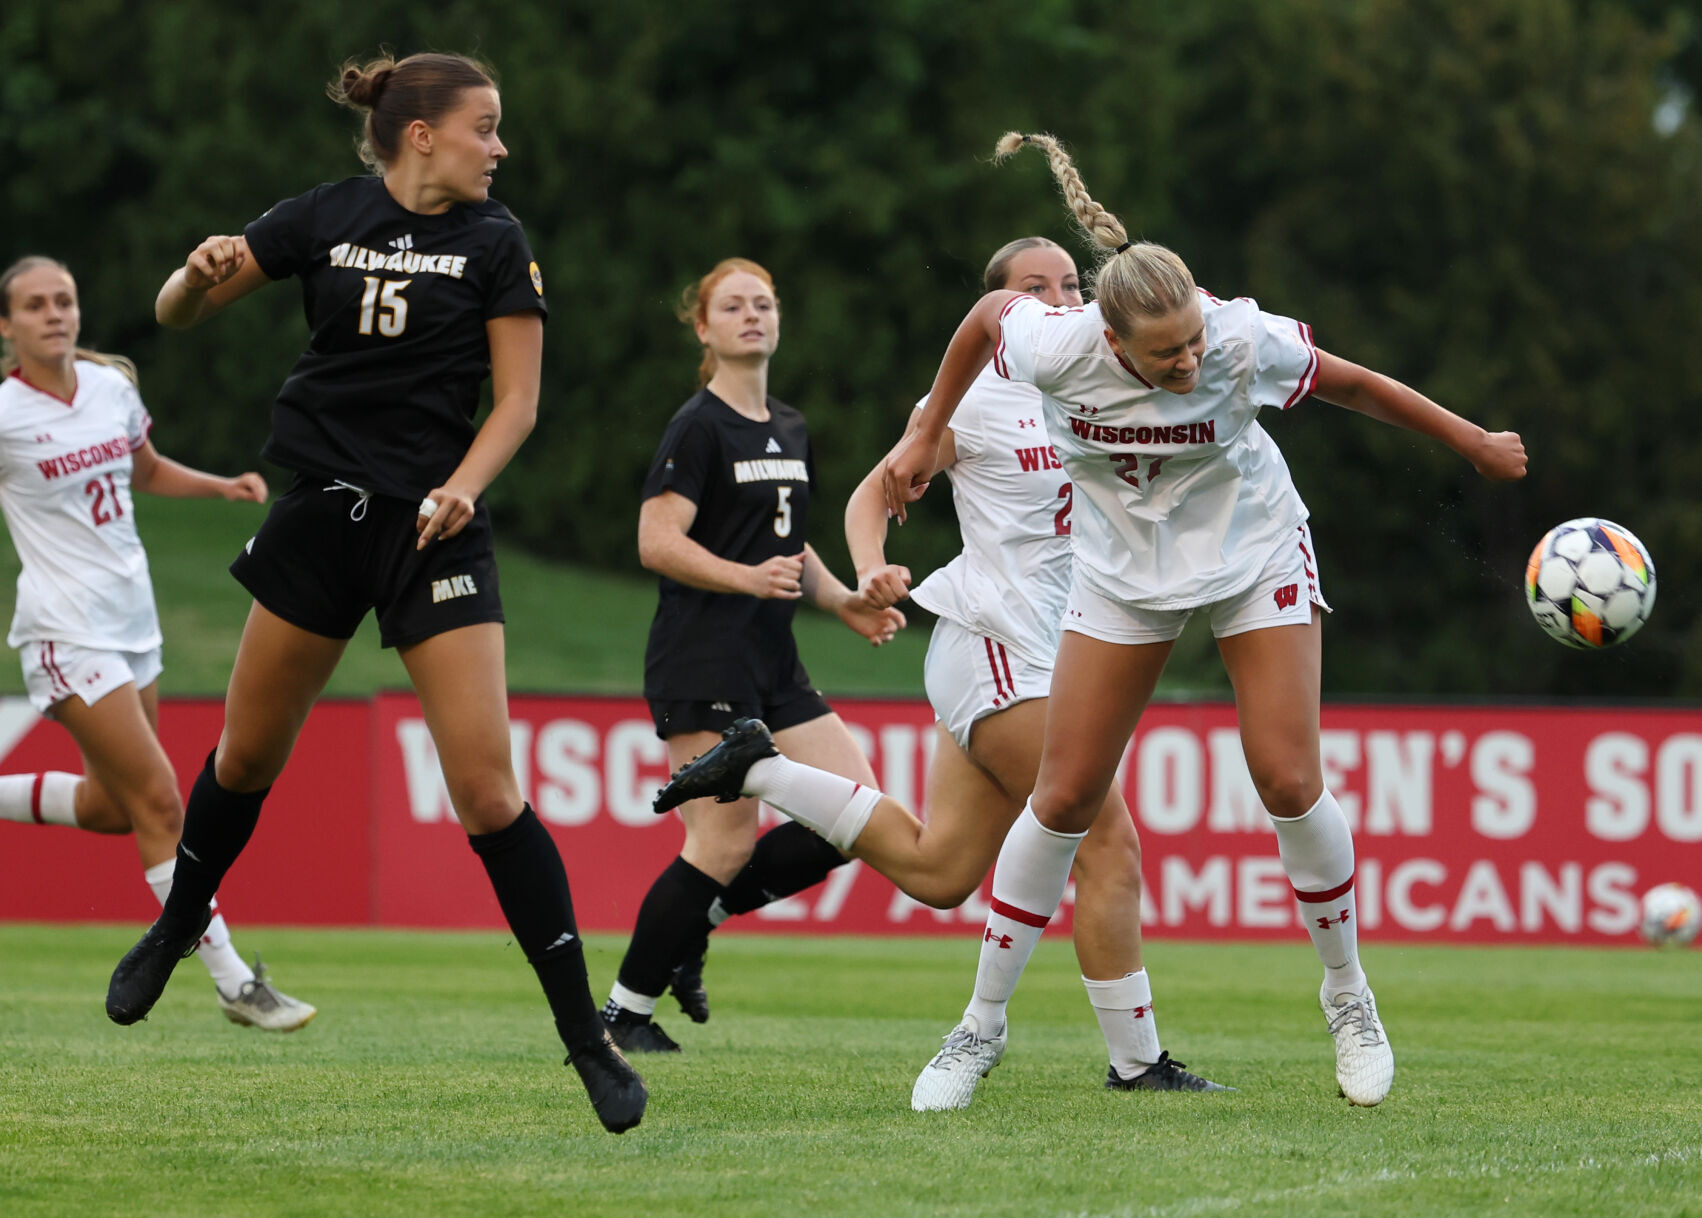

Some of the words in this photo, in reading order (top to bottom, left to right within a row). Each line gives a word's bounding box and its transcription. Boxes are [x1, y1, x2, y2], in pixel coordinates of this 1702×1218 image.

[329, 242, 468, 280] MILWAUKEE
[358, 276, 412, 337] 15
[1069, 416, 1216, 445] WISCONSIN
[37, 436, 130, 480] WISCONSI
[1109, 453, 1173, 489] 27
[84, 472, 124, 527] 21
[773, 486, 793, 538] 5
[1054, 482, 1073, 536] 2
[431, 574, 478, 604] MKE
[1273, 583, 1299, 612] W
[1114, 726, 1537, 841] OMEN'S
